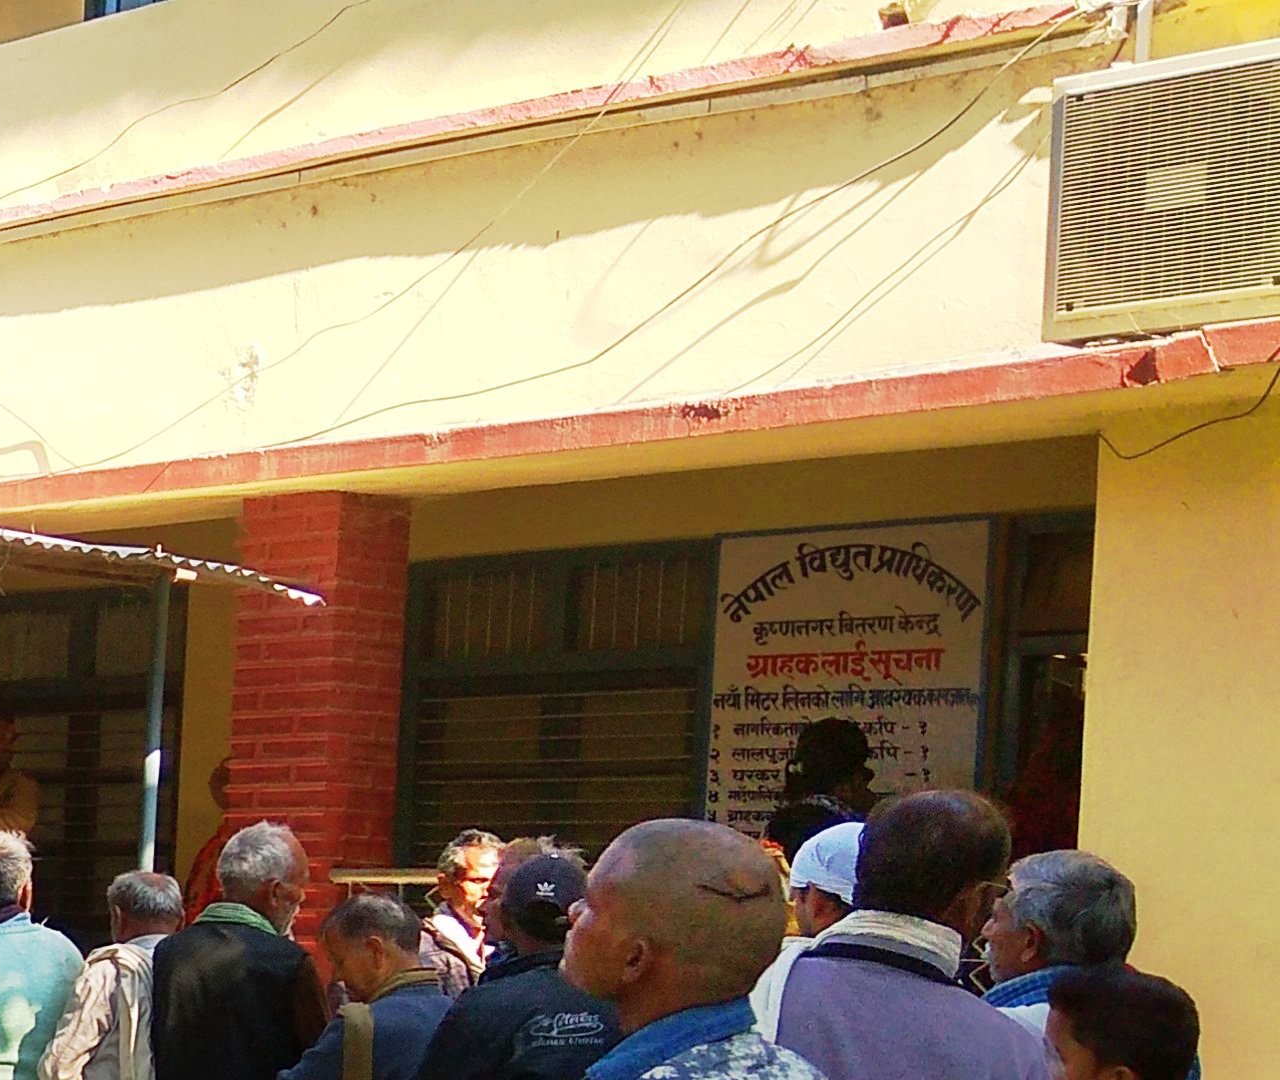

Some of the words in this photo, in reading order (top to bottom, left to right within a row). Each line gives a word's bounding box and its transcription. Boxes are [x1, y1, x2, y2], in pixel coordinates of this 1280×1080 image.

[720, 560, 795, 624] नेपाल
[797, 543, 875, 580] विद्युत
[872, 542, 981, 622] प्राधिकरण
[753, 618, 835, 645] कृष्णनगर
[894, 605, 941, 637] केन्द्र
[868, 647, 945, 685] सूचना
[743, 685, 779, 711] मिटर
[709, 748, 720, 766] २
